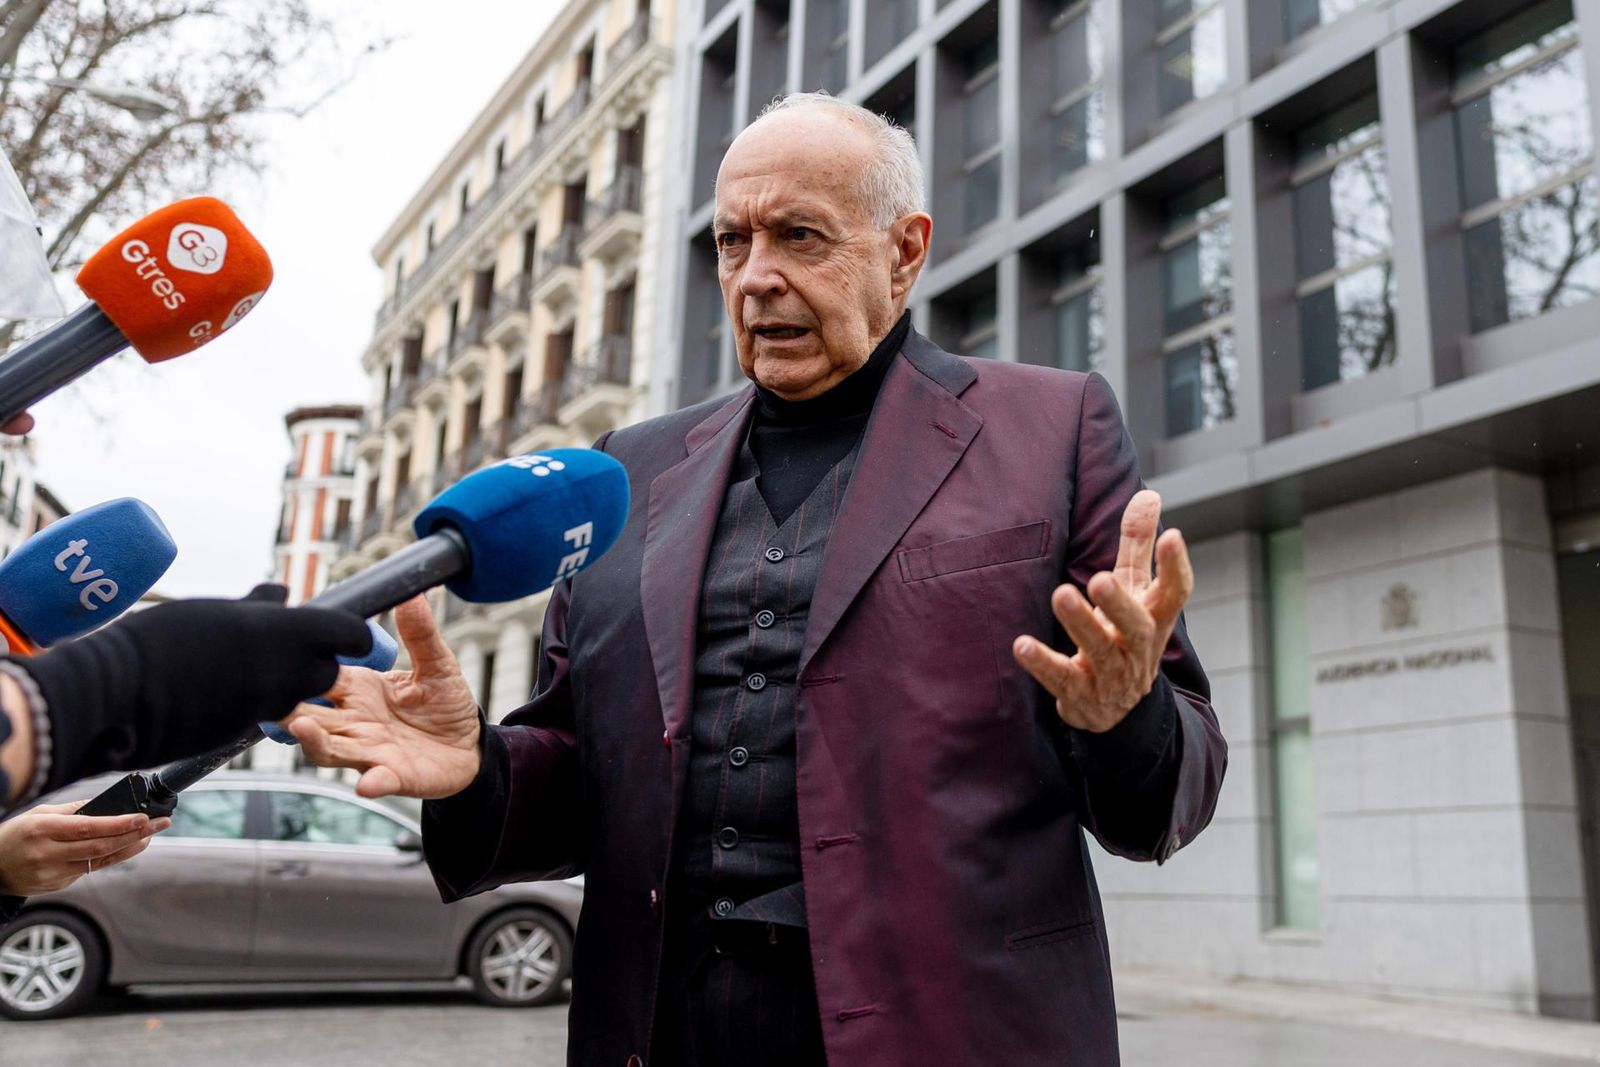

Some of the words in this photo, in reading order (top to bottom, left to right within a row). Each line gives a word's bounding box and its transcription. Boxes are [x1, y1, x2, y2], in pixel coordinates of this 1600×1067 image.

[121, 239, 186, 310] Gtres
[177, 229, 218, 268] G3
[54, 538, 119, 611] tve
